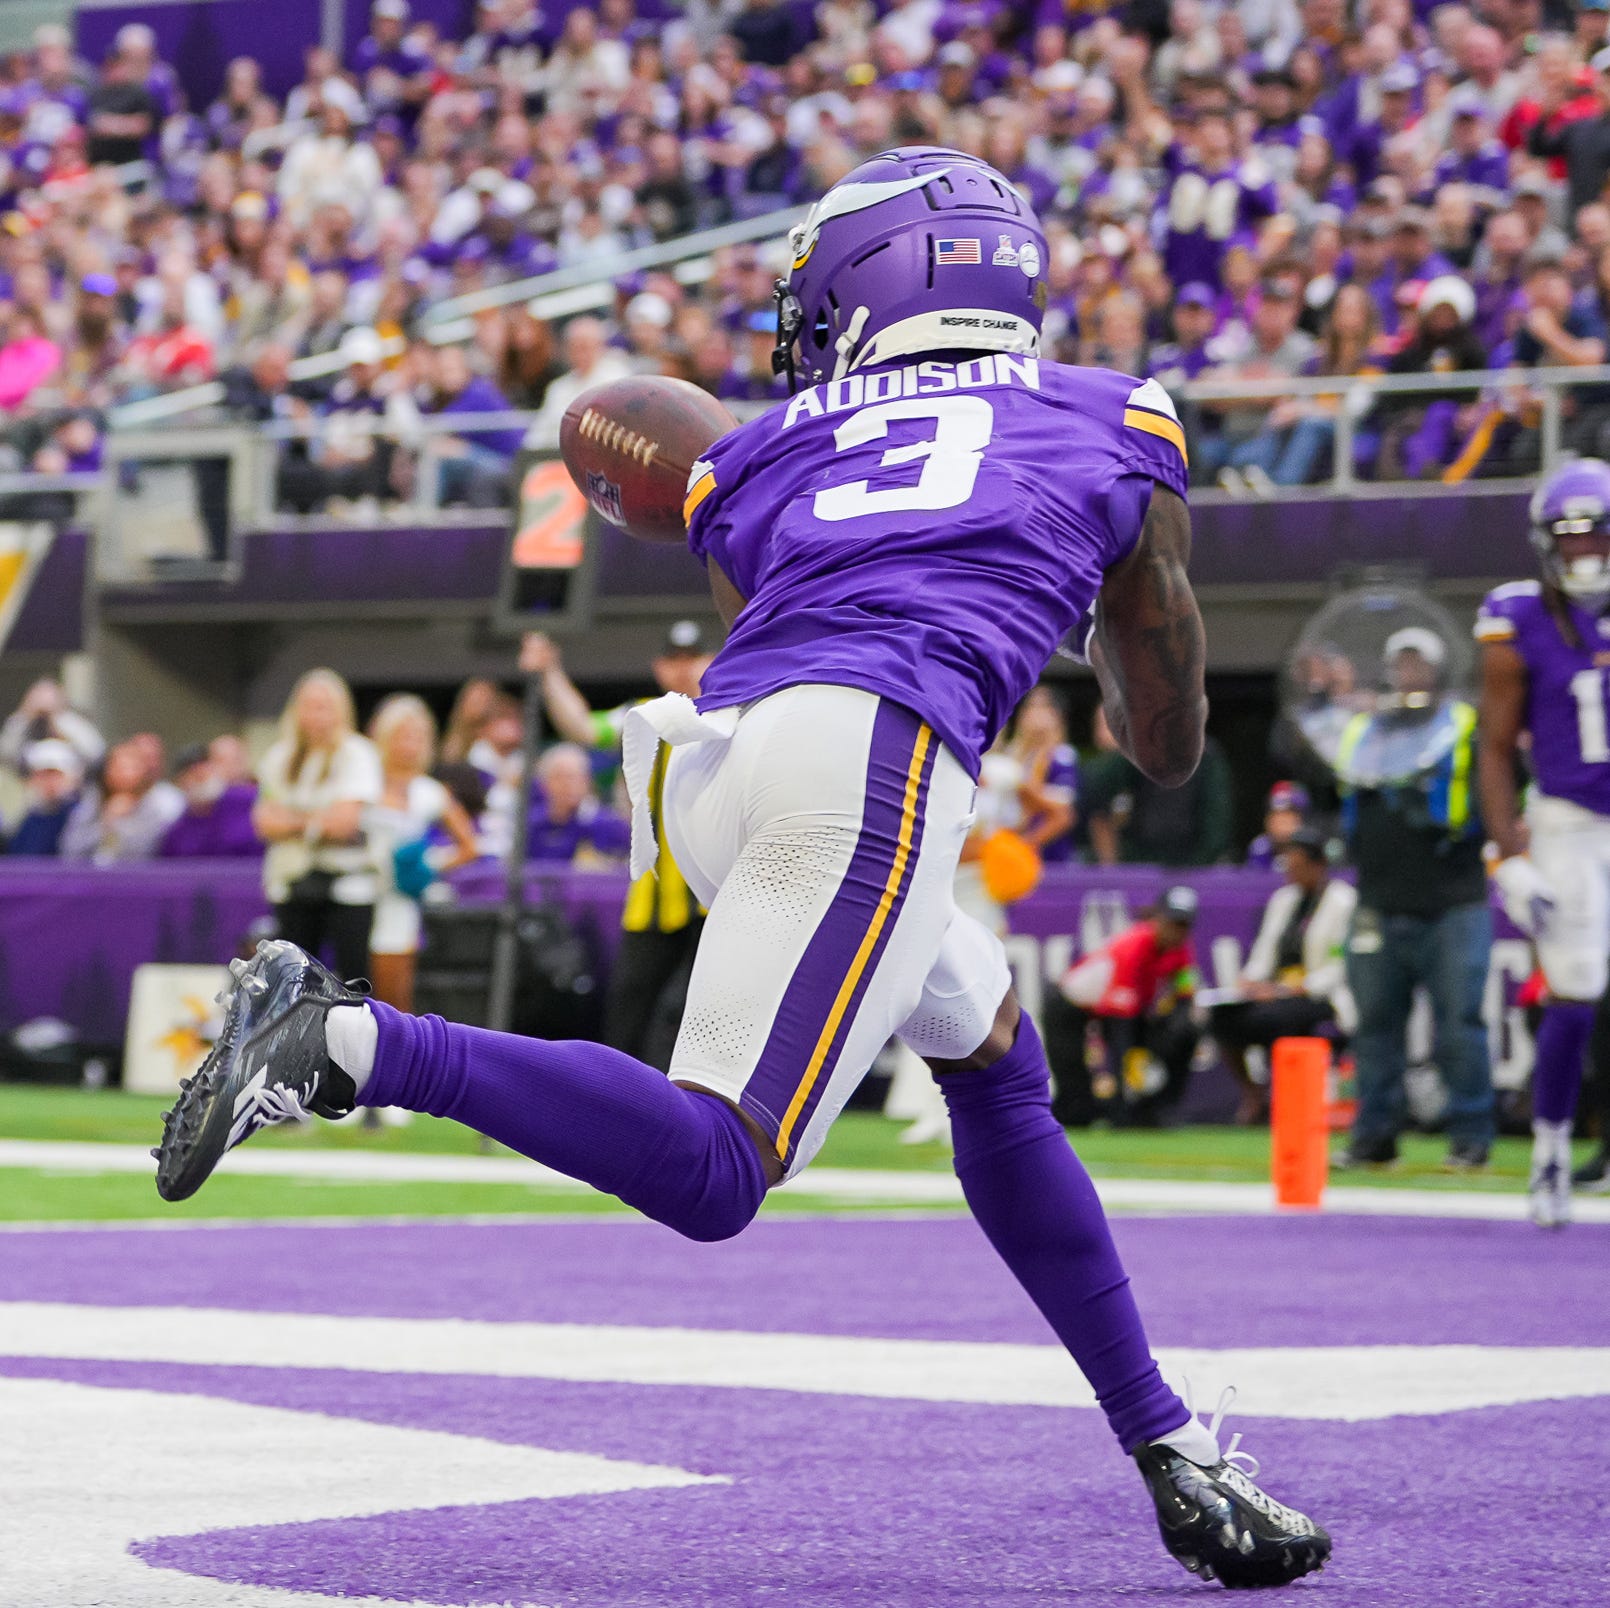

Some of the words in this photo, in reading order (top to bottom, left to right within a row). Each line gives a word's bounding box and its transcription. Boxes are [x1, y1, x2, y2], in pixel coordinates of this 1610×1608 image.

[940, 316, 981, 328] INSPIRE
[982, 319, 1018, 331] CHANGE
[782, 353, 1041, 430] ADDISON
[813, 395, 994, 522] 3
[512, 459, 588, 568] 2
[1568, 668, 1610, 763] 1
